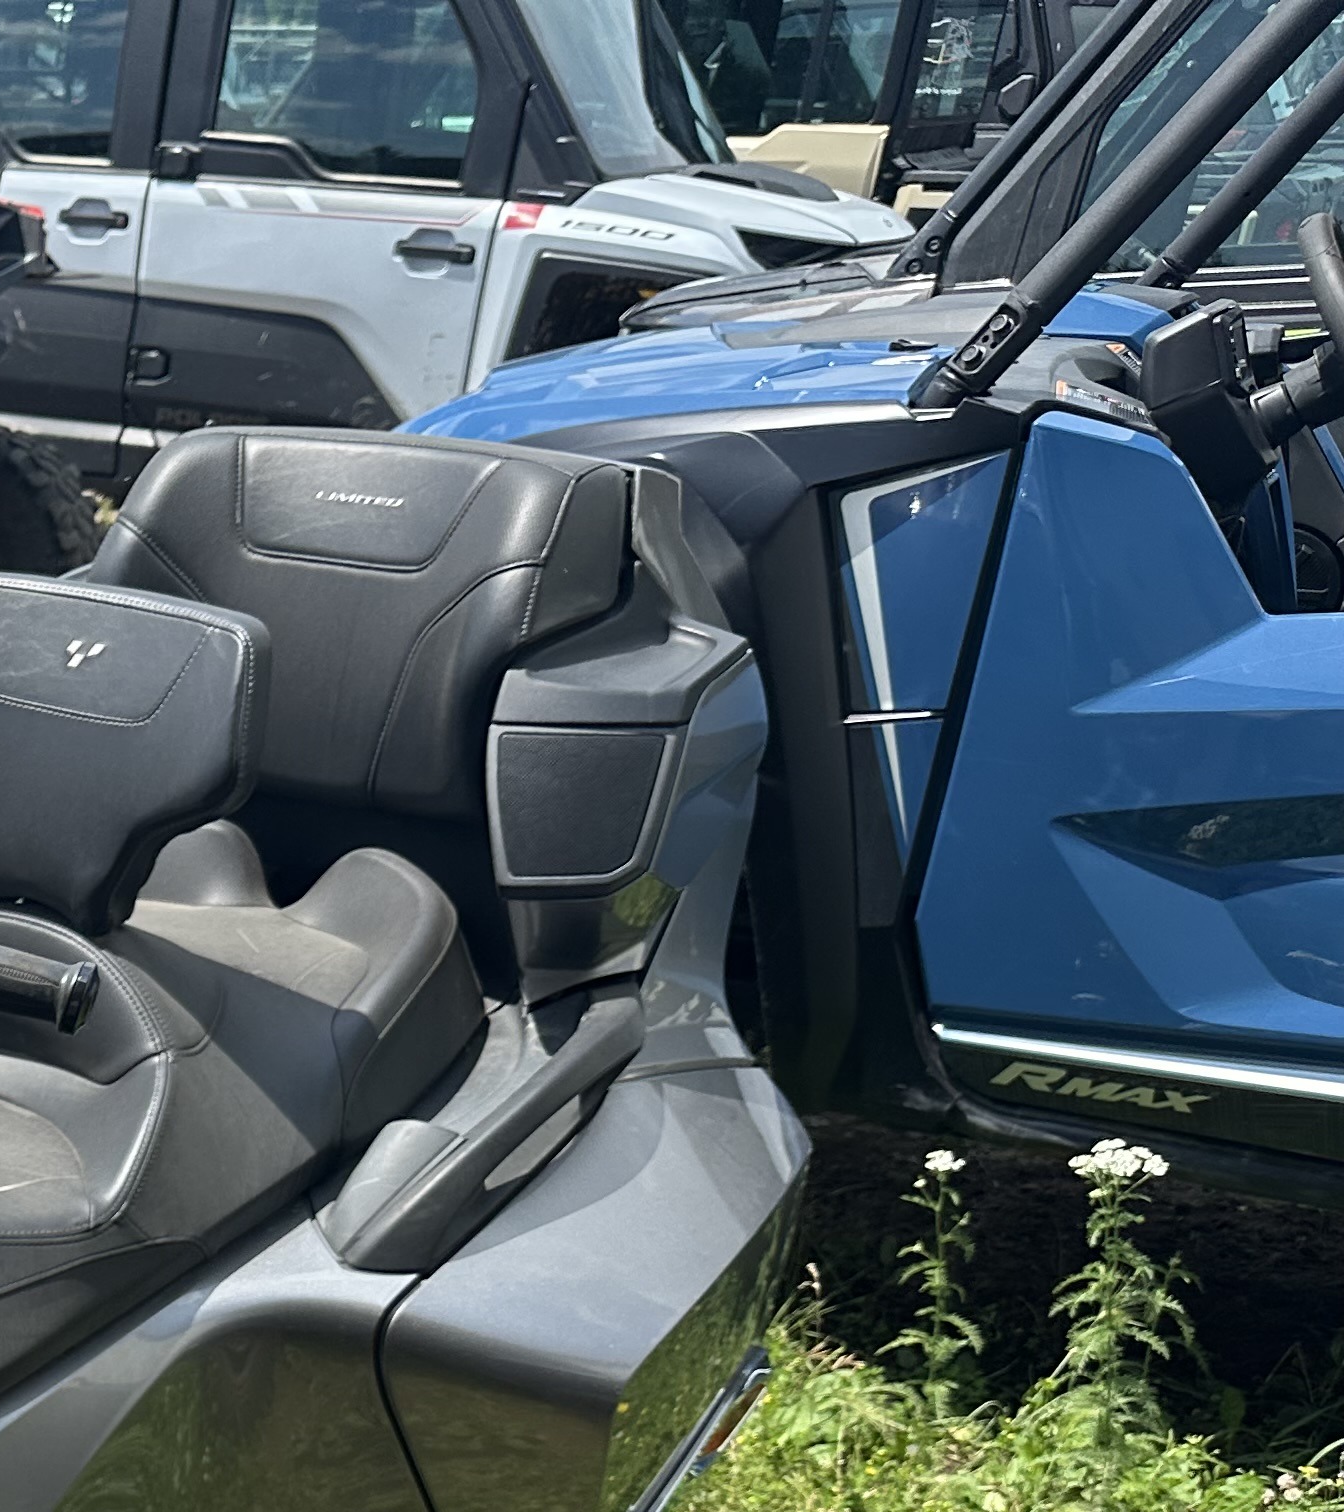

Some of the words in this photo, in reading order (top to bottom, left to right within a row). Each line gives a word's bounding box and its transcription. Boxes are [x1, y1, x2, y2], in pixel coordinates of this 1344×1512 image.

[560, 219, 675, 241] 1500
[315, 490, 405, 508] LIMITED
[989, 1061, 1212, 1114] RMAX
